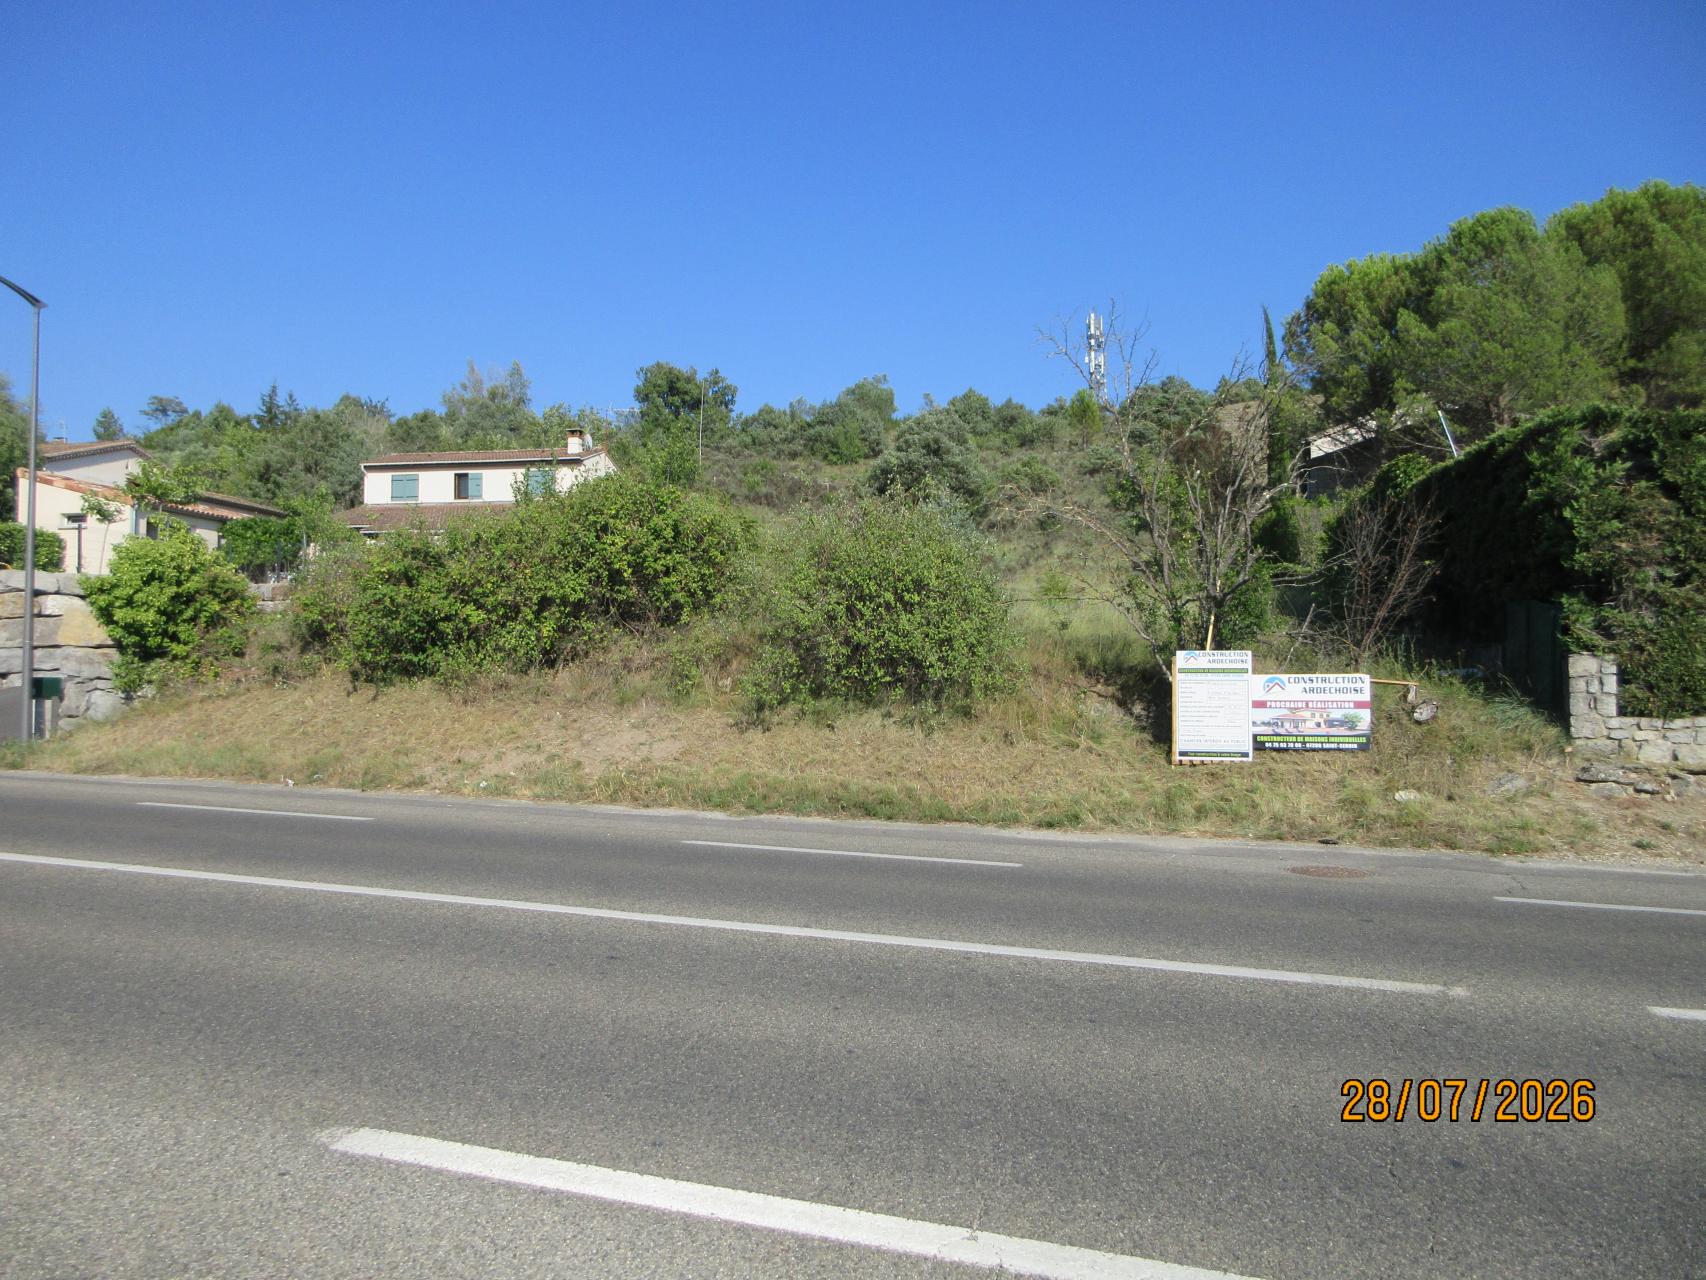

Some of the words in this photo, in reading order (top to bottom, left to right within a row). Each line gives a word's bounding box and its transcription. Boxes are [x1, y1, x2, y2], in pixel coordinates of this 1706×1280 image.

[1287, 676, 1365, 684] CONSTRUCTION
[1301, 686, 1365, 694] ARDECHOISE
[1266, 700, 1307, 708] PROCHAINE
[1309, 700, 1354, 708] RÉALISATION
